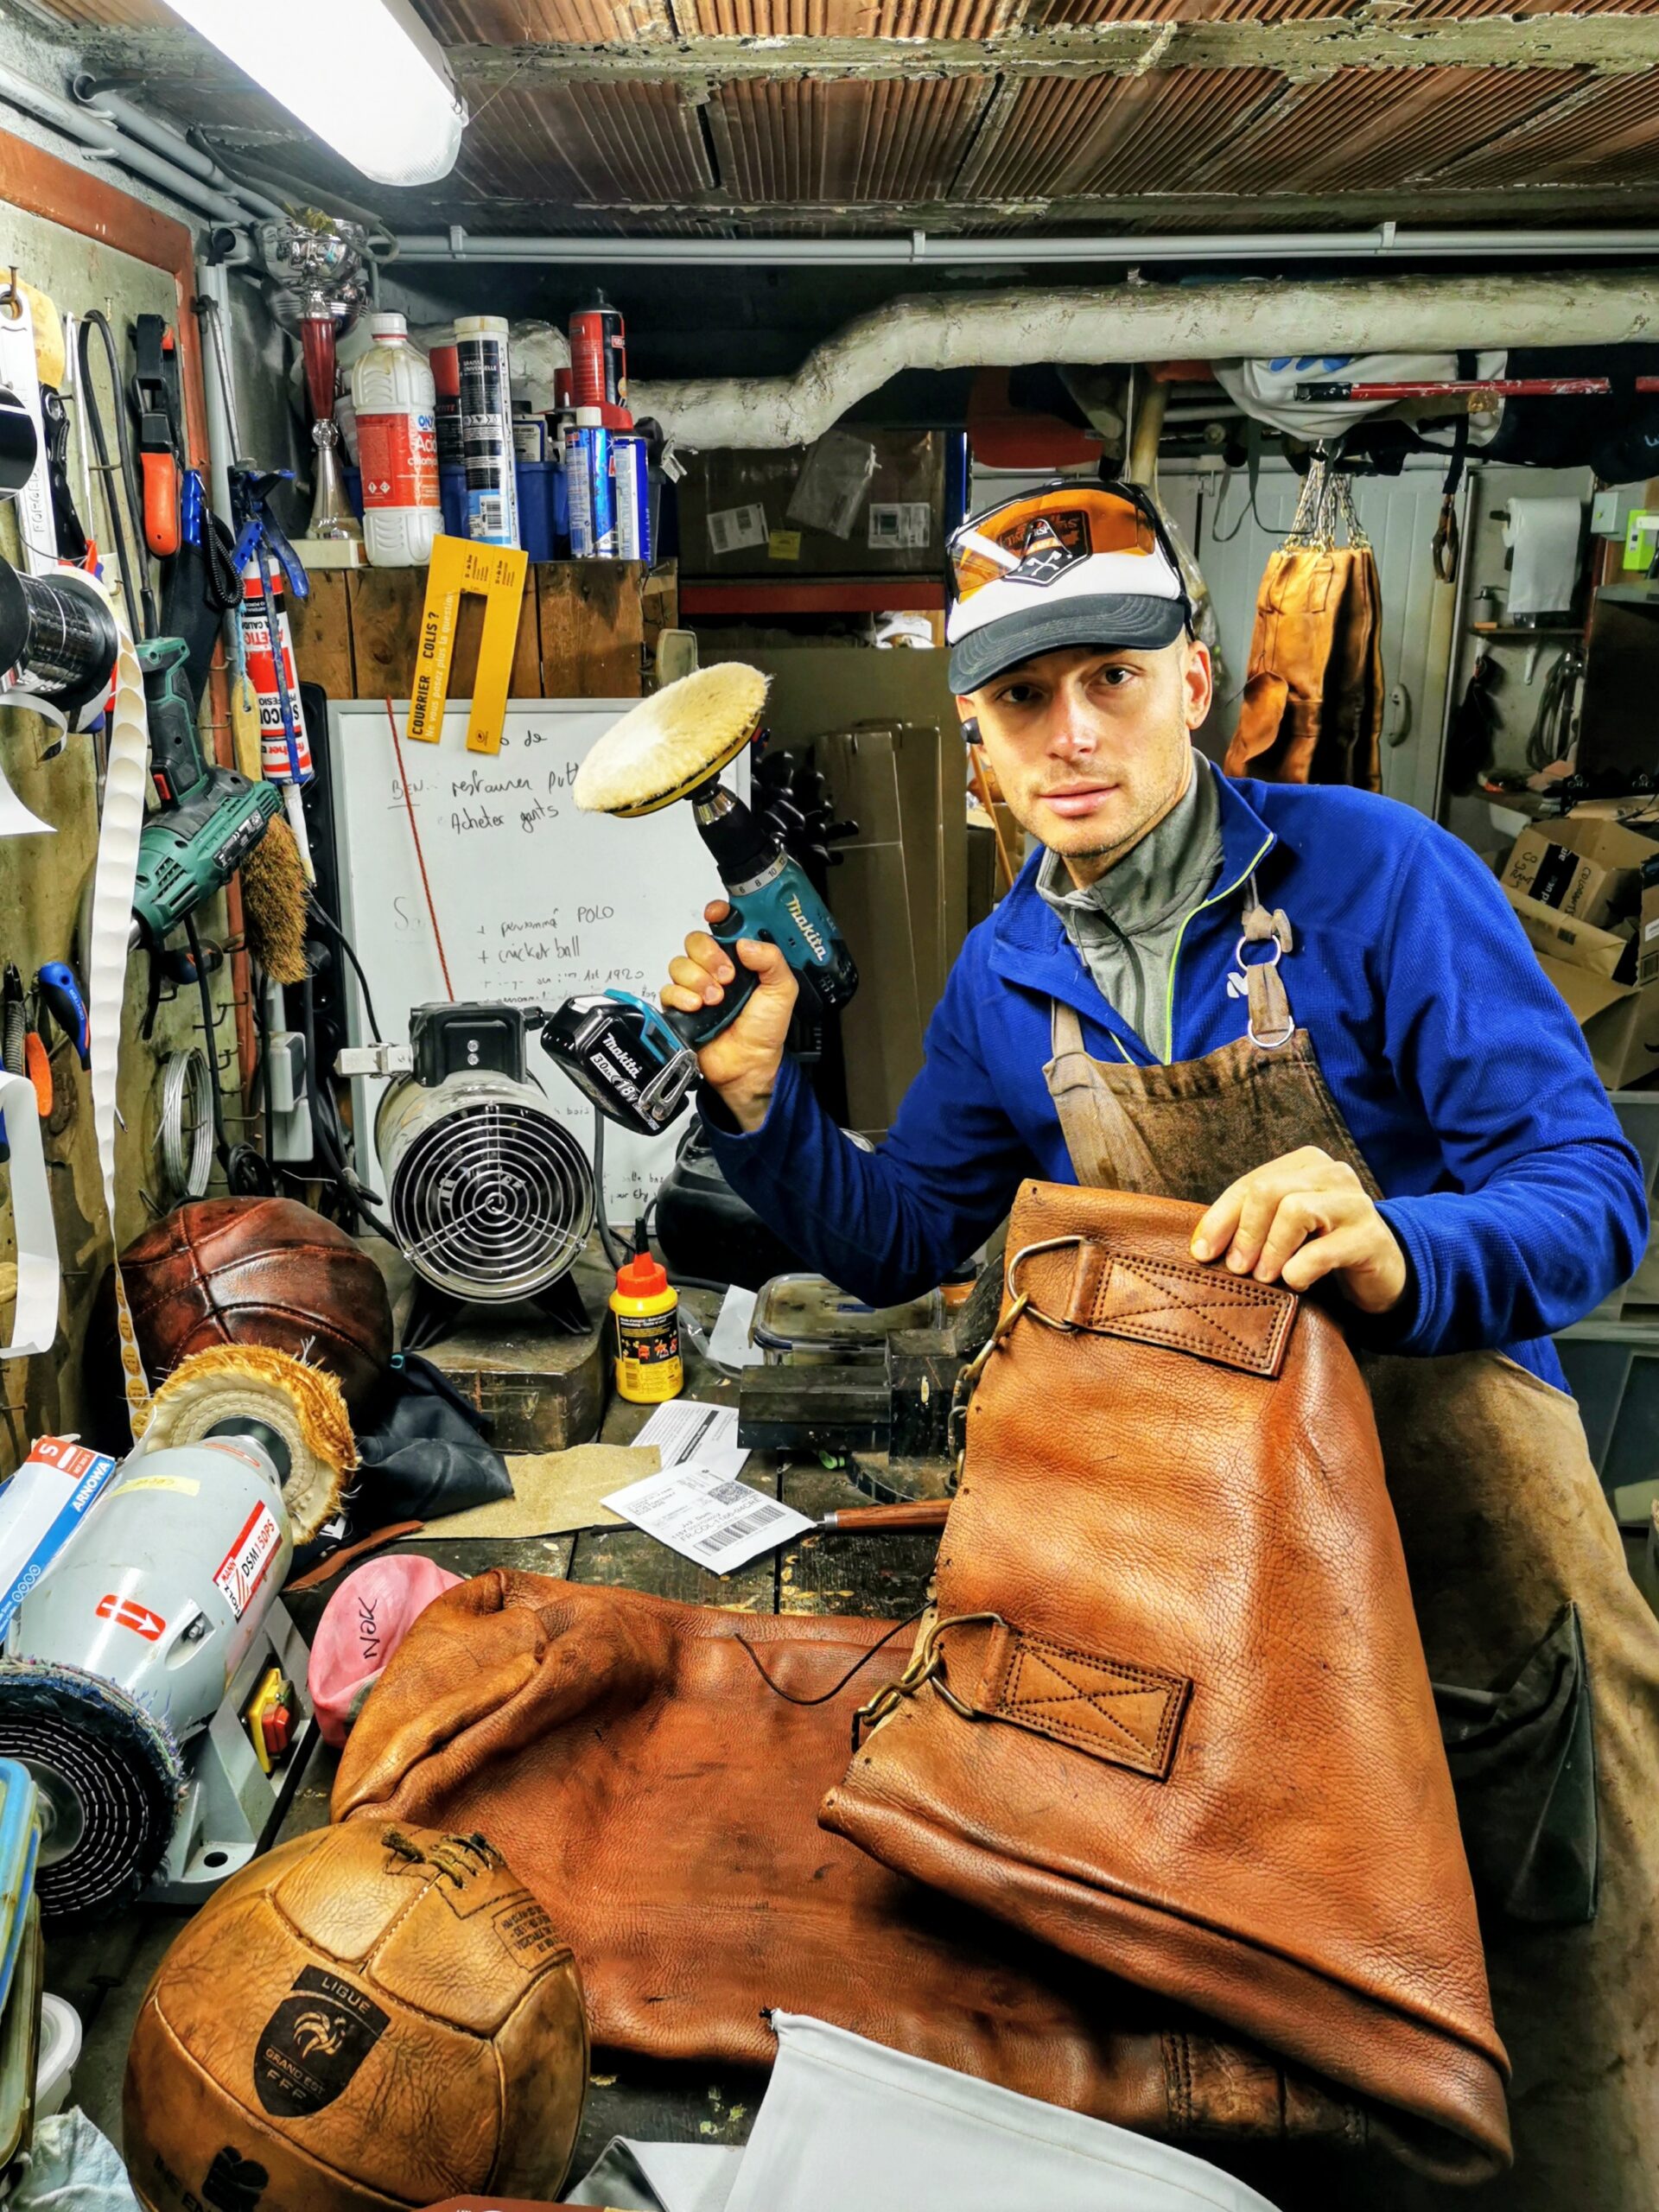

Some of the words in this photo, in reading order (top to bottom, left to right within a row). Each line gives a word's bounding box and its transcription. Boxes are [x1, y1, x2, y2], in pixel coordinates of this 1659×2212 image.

[428, 611, 440, 620] ?
[423, 623, 438, 659] COLIS
[439, 635, 448, 645] la
[436, 648, 447, 669] plus
[433, 669, 443, 698] posez
[412, 675, 431, 735] COURRIER
[429, 699, 439, 722] vous
[425, 724, 435, 738] Ne
[451, 805, 505, 835] Acheter
[520, 798, 560, 834] gants
[755, 879, 762, 887] 8
[768, 868, 778, 878] 10
[577, 905, 614, 924] POLO
[499, 943, 550, 963] cricket
[555, 936, 580, 958] ball
[39, 1443, 59, 1458] S
[72, 1461, 111, 1512] ARNOWA
[225, 1585, 241, 1615] HOLZ
[321, 1976, 371, 2015] LIGUE
[265, 2048, 302, 2078] GRAND
[303, 2075, 326, 2095] EST
